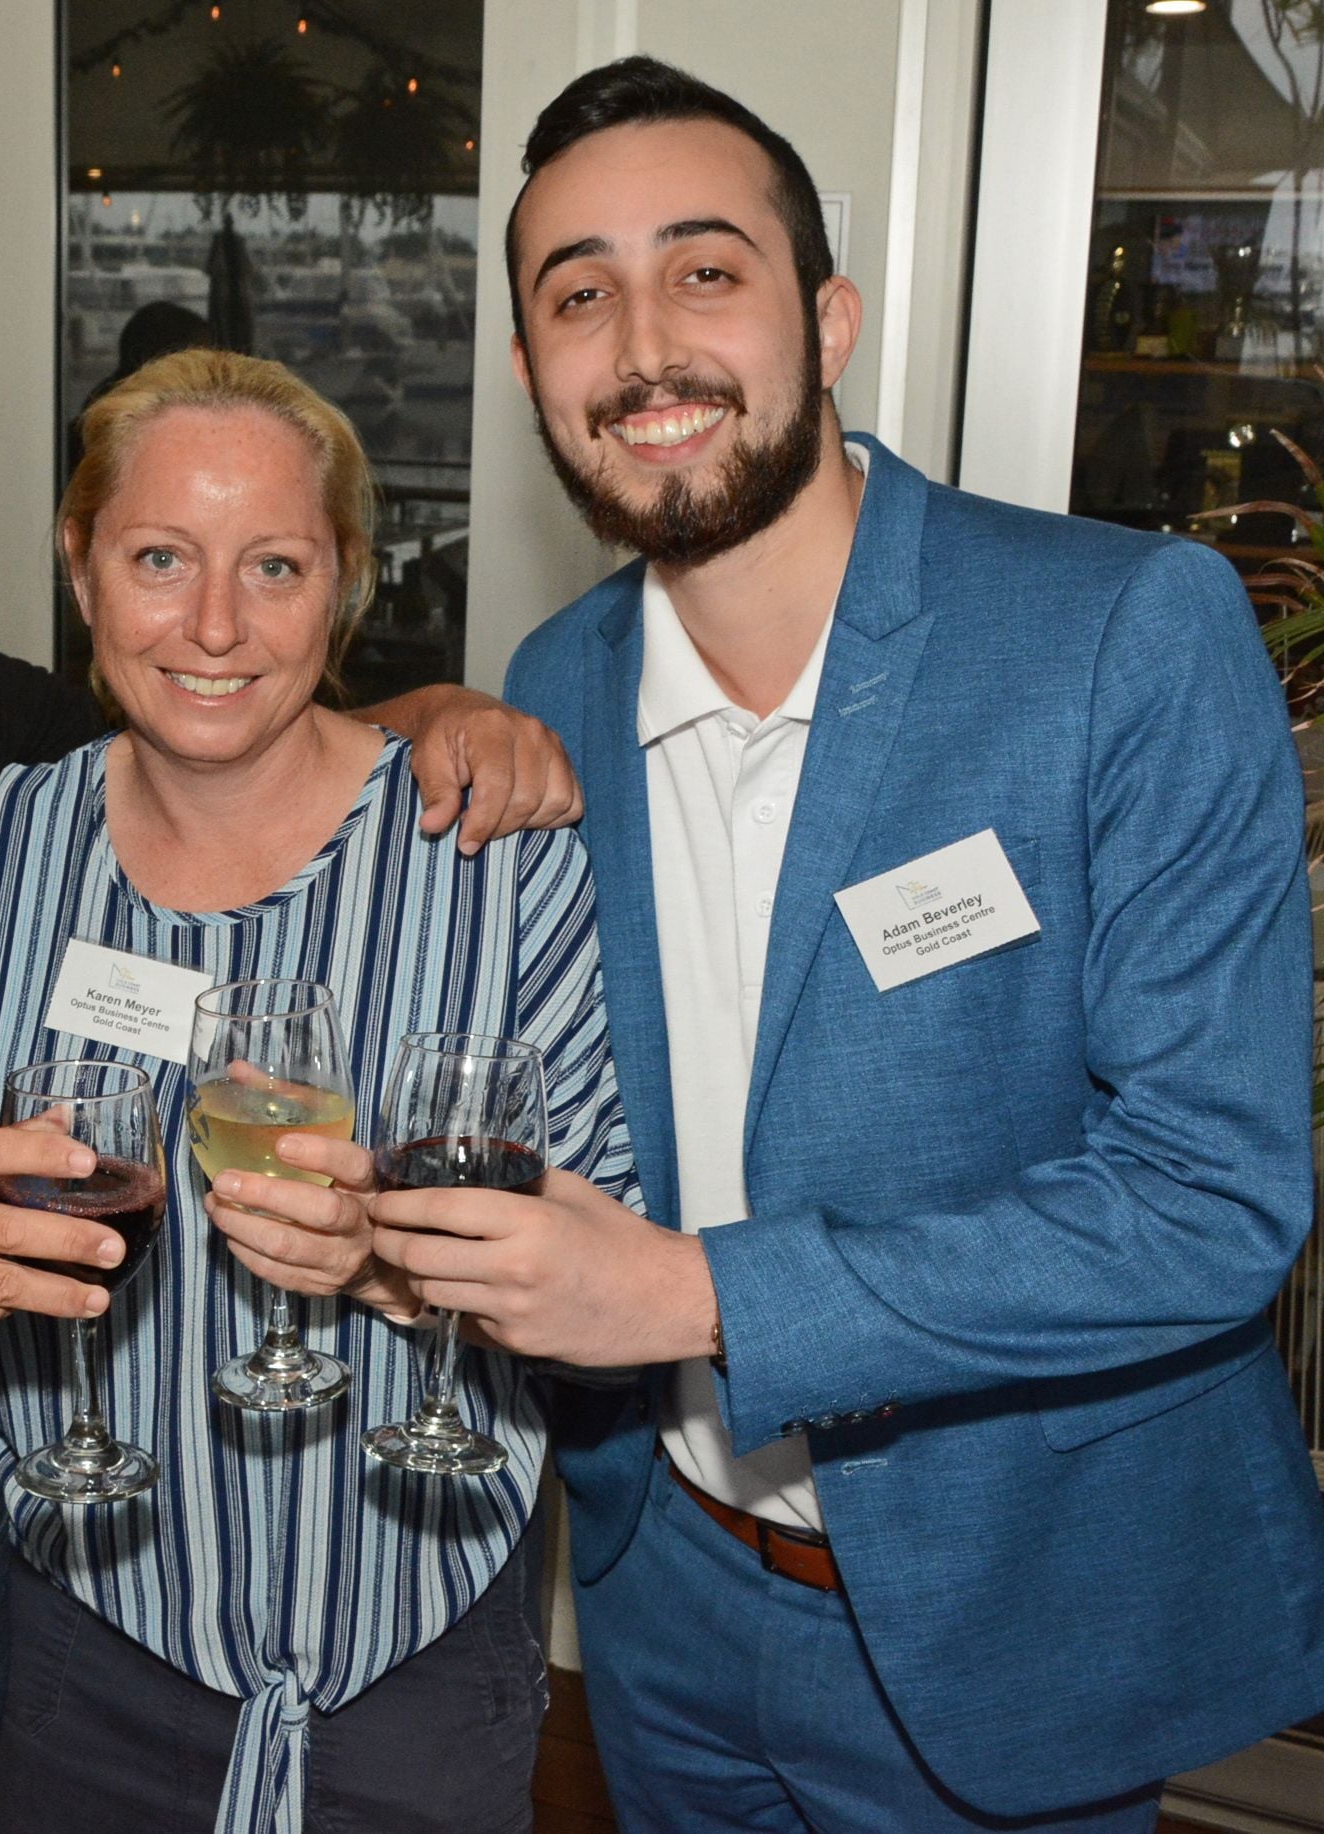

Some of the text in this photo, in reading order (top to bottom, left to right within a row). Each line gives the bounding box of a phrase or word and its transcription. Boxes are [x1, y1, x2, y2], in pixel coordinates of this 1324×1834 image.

[882, 918, 921, 941] Adam
[922, 893, 984, 925] Beverley
[882, 905, 996, 956] Optus Business Centre
[915, 928, 973, 957] Gold Coast
[70, 998, 170, 1032] Optus Business Centre
[86, 988, 162, 1018] Karen Meyer
[92, 1015, 142, 1035] Gold Coast
